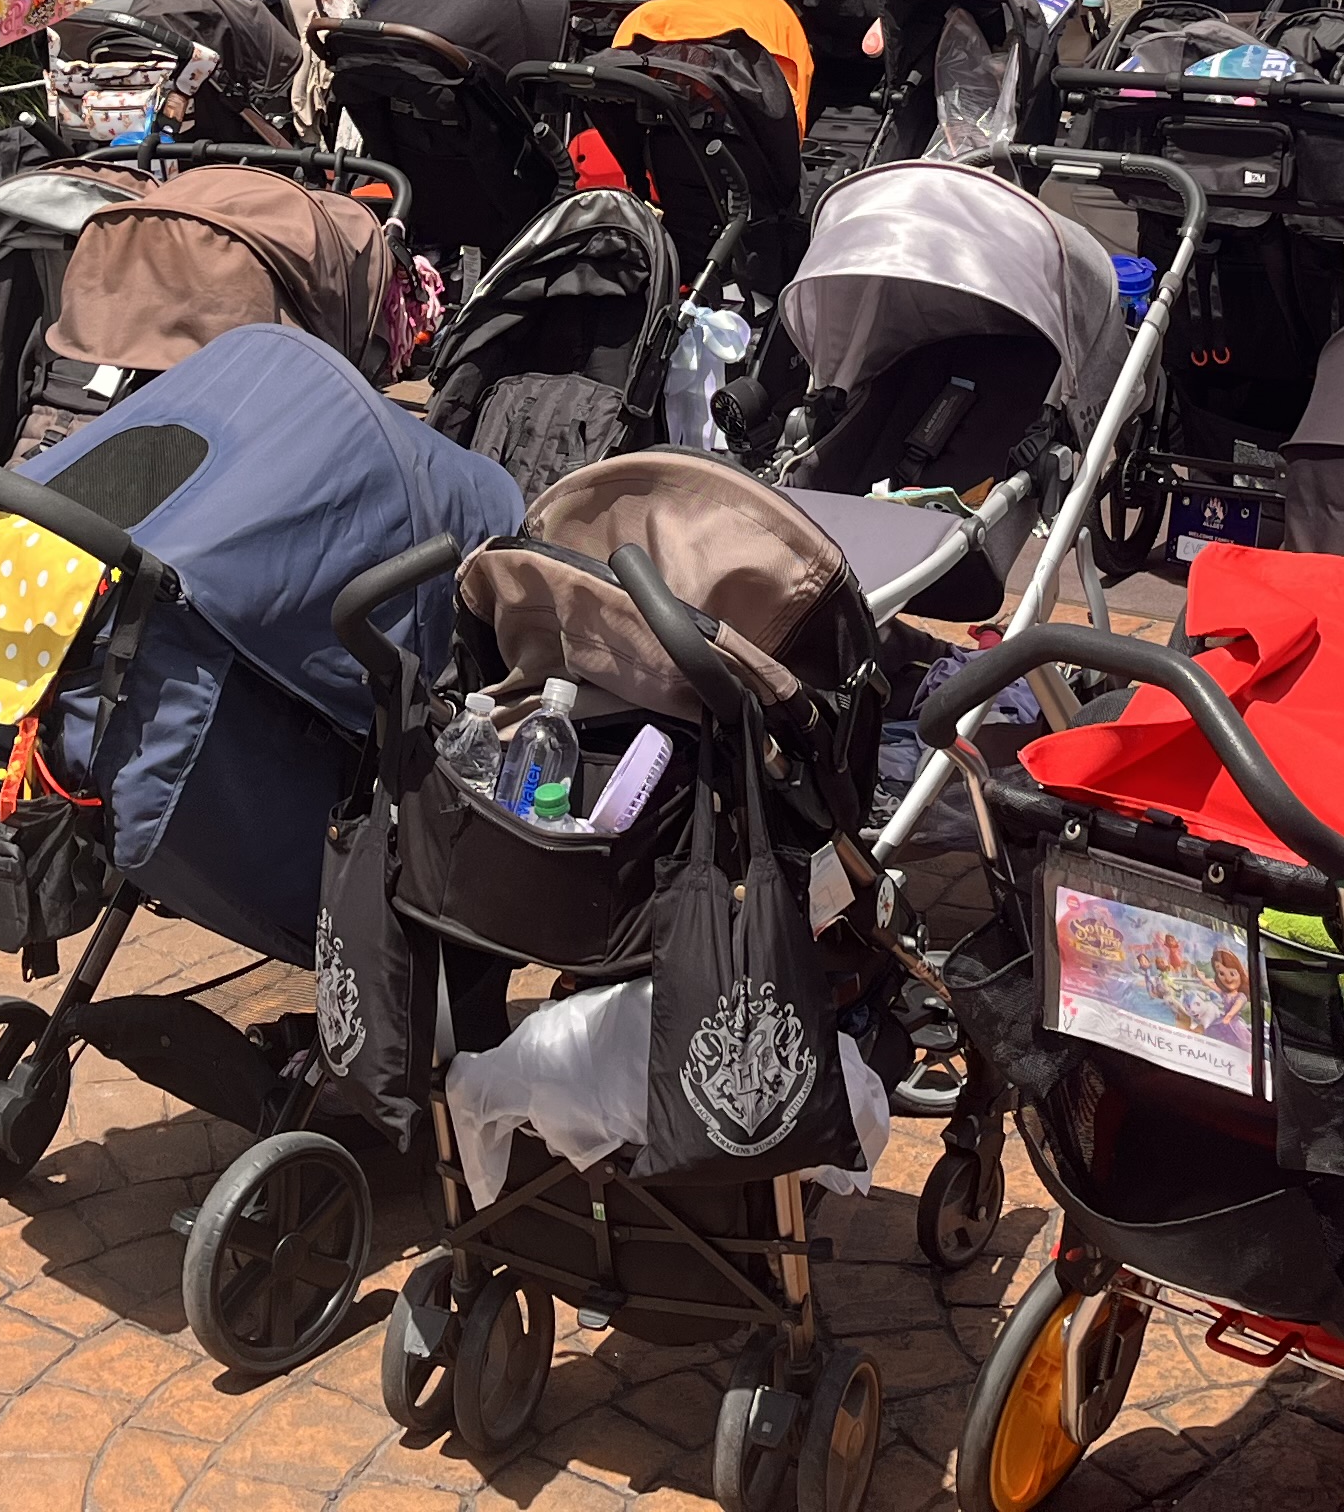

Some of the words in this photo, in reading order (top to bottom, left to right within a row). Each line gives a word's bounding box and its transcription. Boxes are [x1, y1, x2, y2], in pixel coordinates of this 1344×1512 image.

[1118, 1022, 1173, 1053] HAINES
[1178, 1044, 1234, 1076] FAMILY
[690, 1097, 712, 1123] DRACO
[710, 1133, 751, 1155] DORMIENS
[753, 1124, 791, 1153] NUNQUAM
